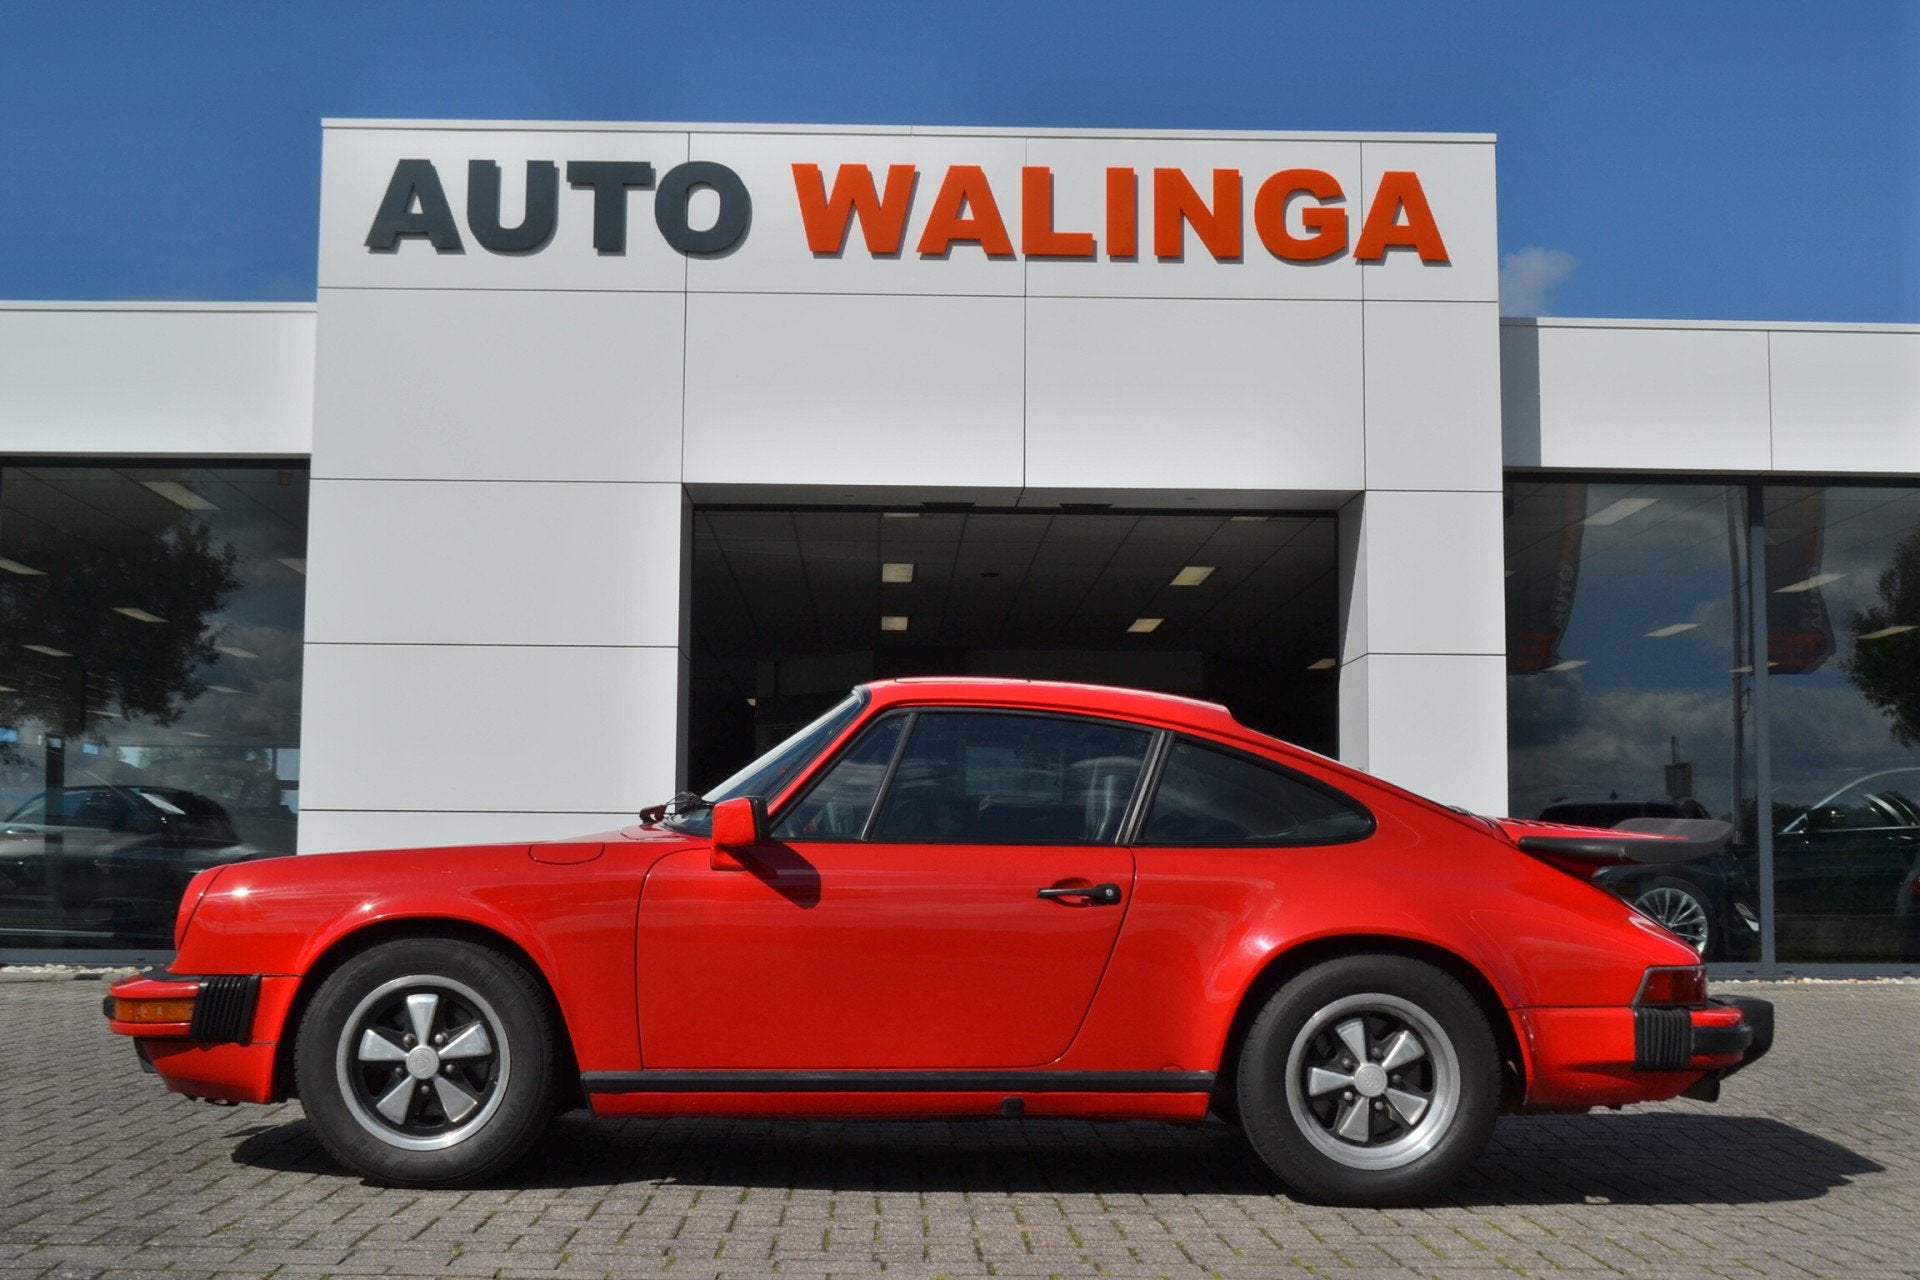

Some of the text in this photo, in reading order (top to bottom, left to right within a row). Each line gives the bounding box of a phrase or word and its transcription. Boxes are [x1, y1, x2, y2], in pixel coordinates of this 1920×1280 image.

[365, 159, 1450, 264] AUTO WALINGA
[1551, 562, 1574, 628] AUTO
